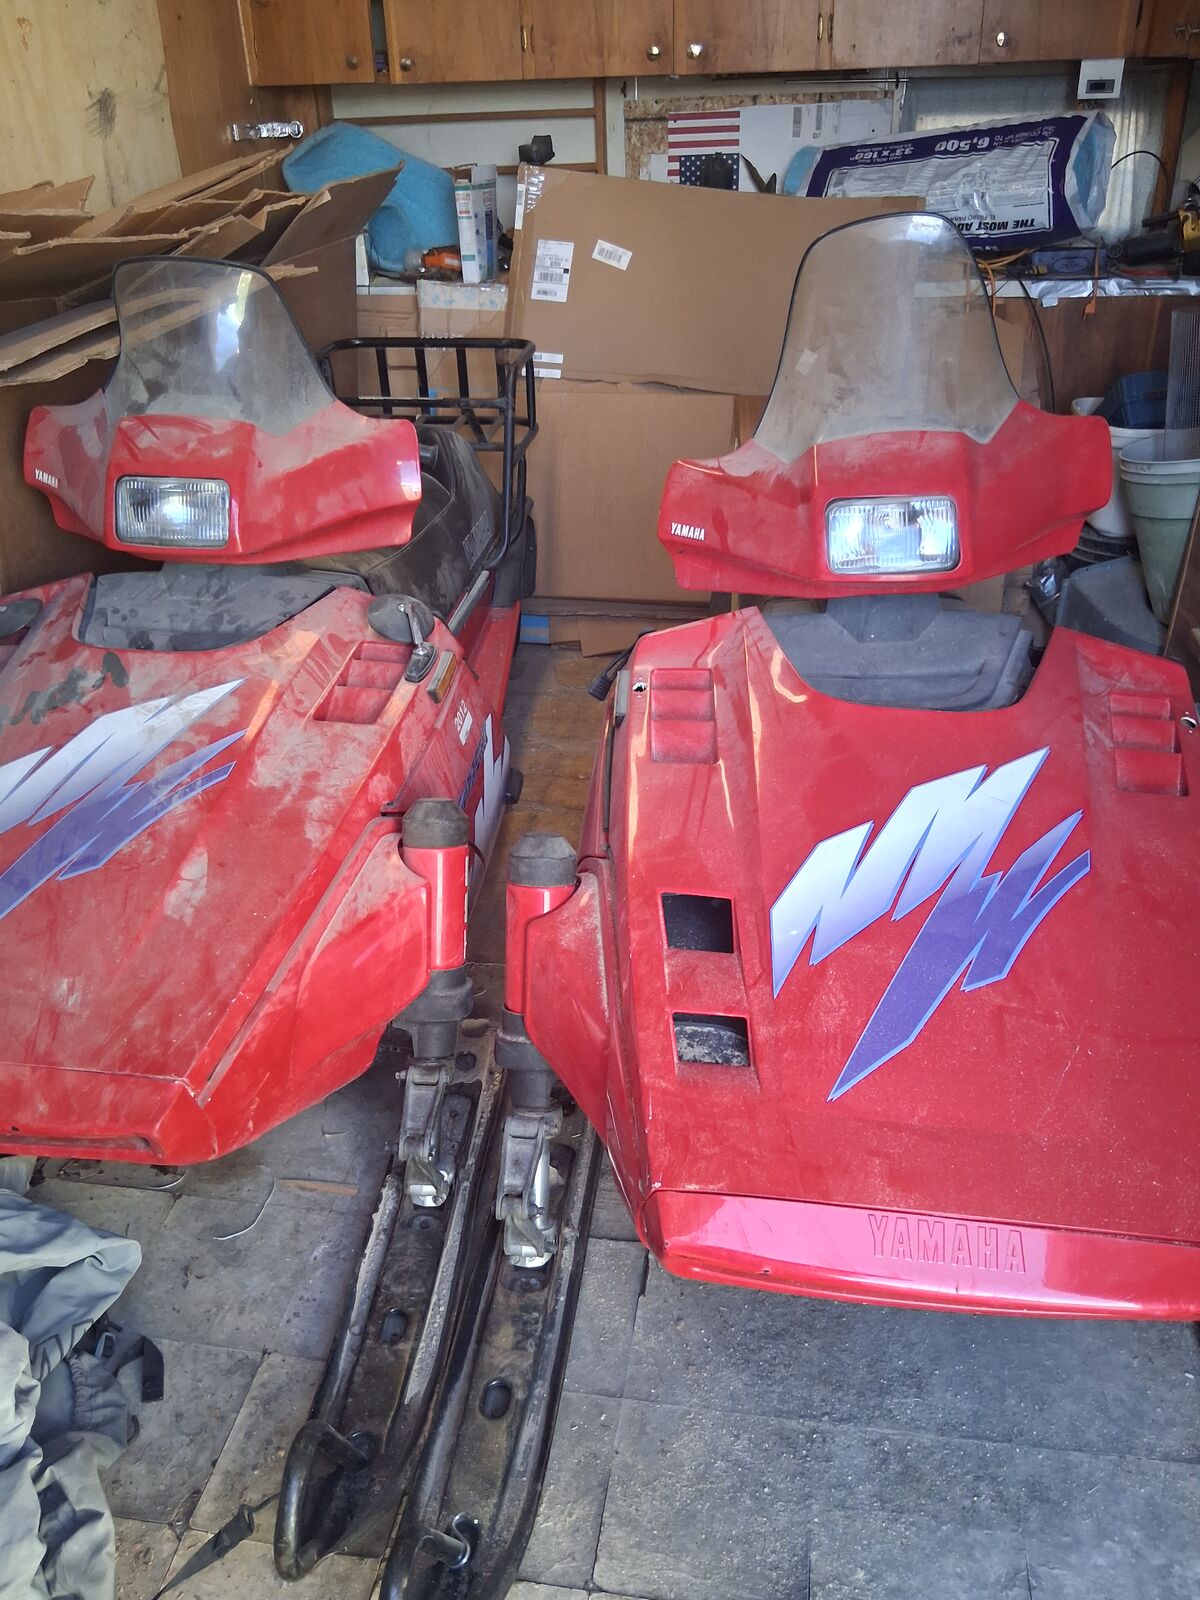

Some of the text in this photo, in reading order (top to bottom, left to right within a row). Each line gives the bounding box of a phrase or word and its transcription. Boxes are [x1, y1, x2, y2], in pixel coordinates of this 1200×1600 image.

[934, 136, 990, 152] 6,500
[975, 221, 1009, 232] MOST
[1012, 218, 1035, 229] THE
[35, 468, 58, 489] YAMAHA
[671, 522, 705, 541] YAMAHA
[454, 699, 467, 732] 2012
[868, 1213, 1026, 1273] YAMAHA
